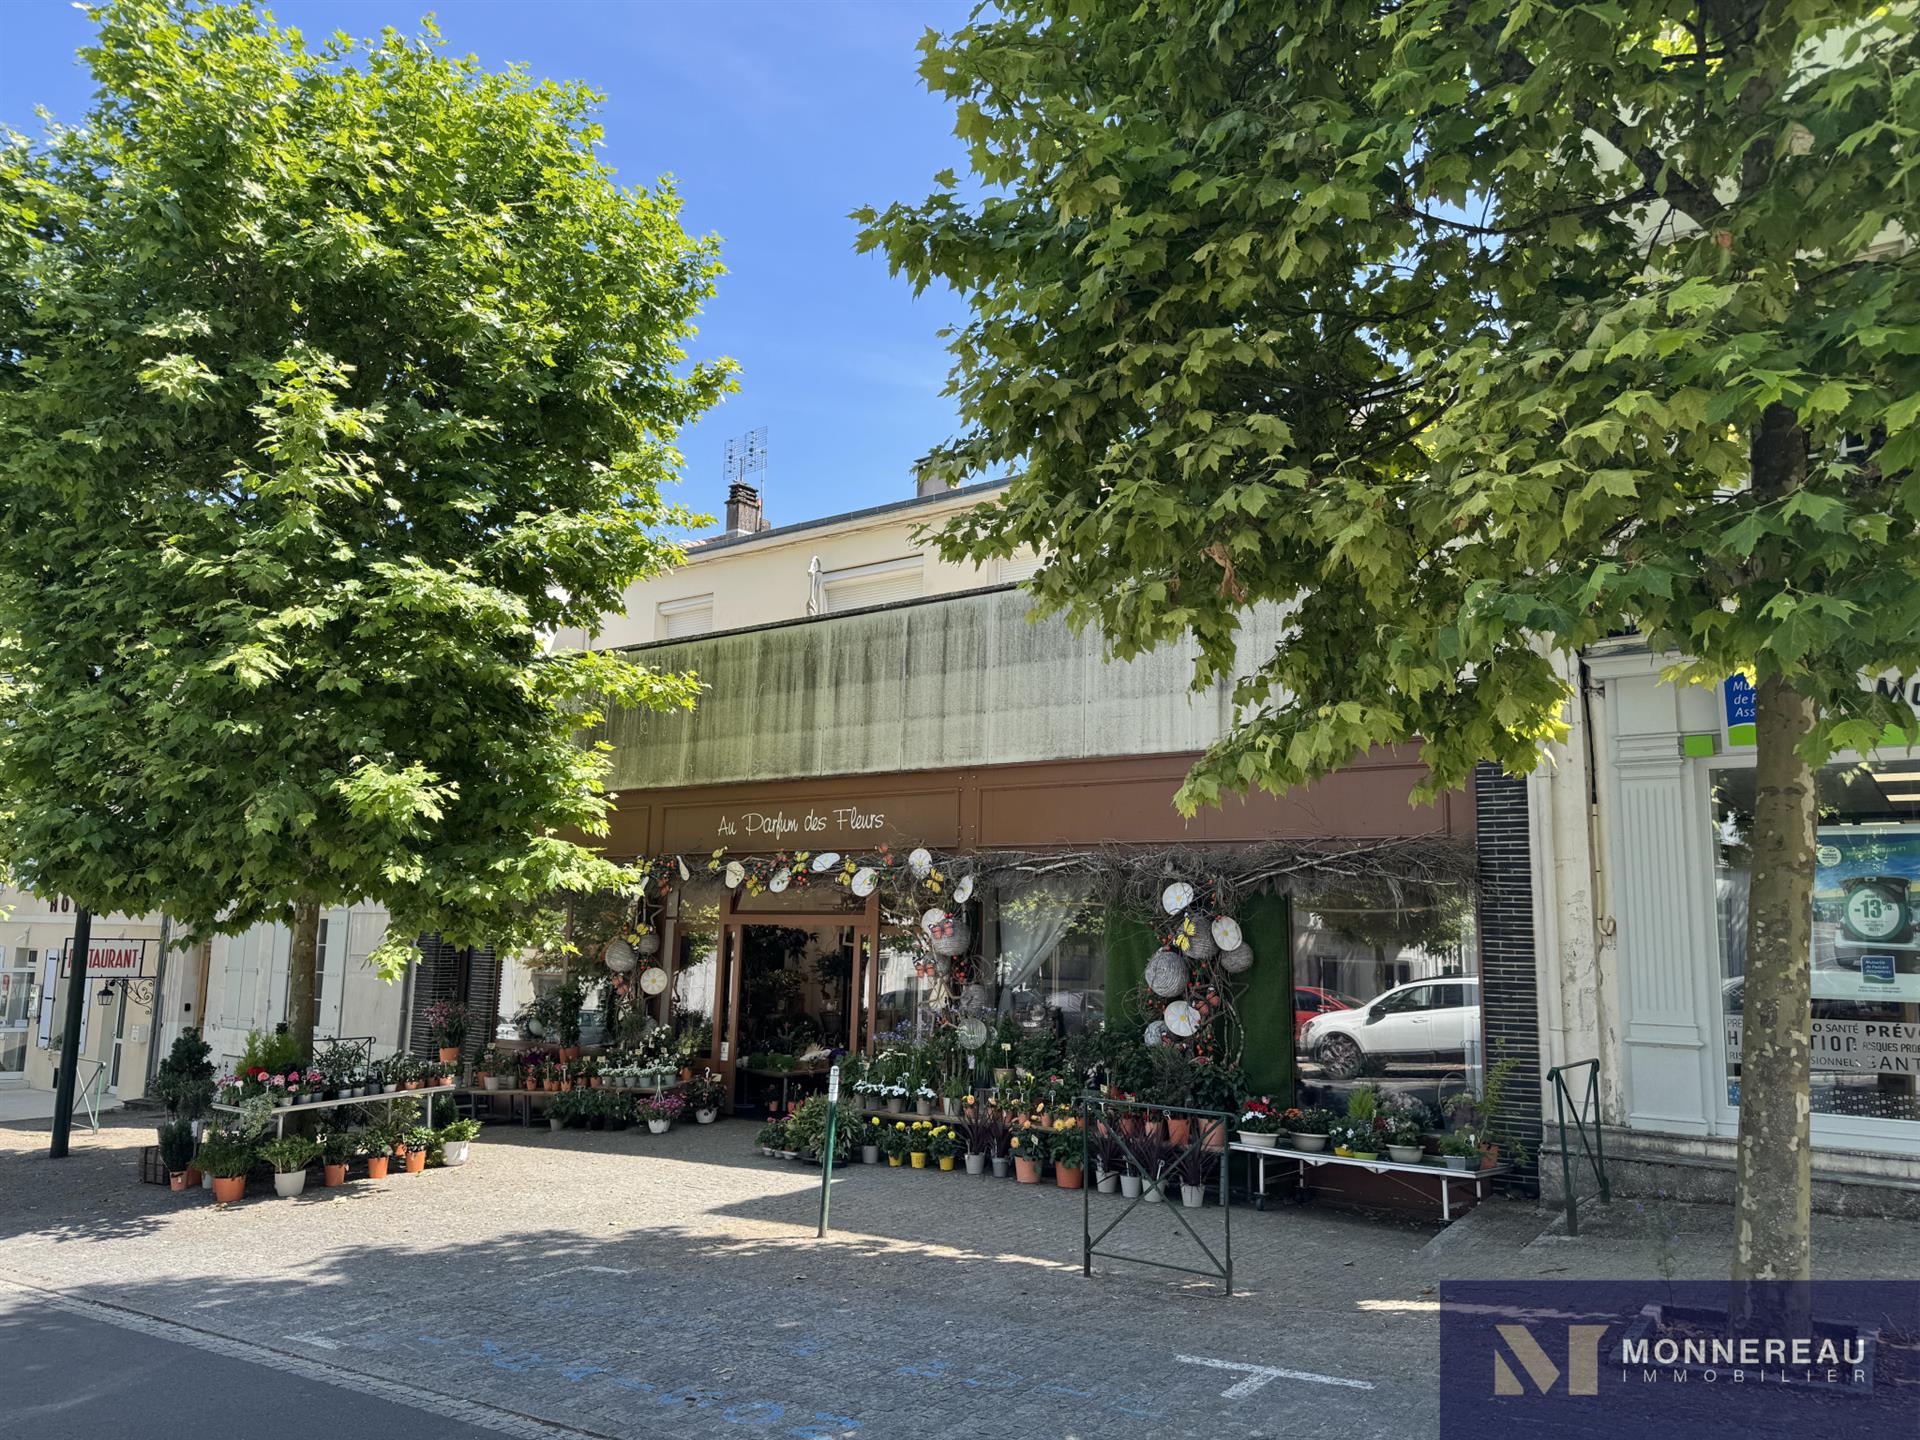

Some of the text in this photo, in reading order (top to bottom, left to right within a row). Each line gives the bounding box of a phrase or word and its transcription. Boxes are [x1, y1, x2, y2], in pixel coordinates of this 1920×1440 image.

[1733, 694, 1749, 705] de
[1735, 707, 1757, 718] Ass
[717, 806, 885, 841] Au Parfum des Fleurs
[67, 948, 139, 969] RTAURANT
[1865, 1023, 1920, 1039] PRÉV
